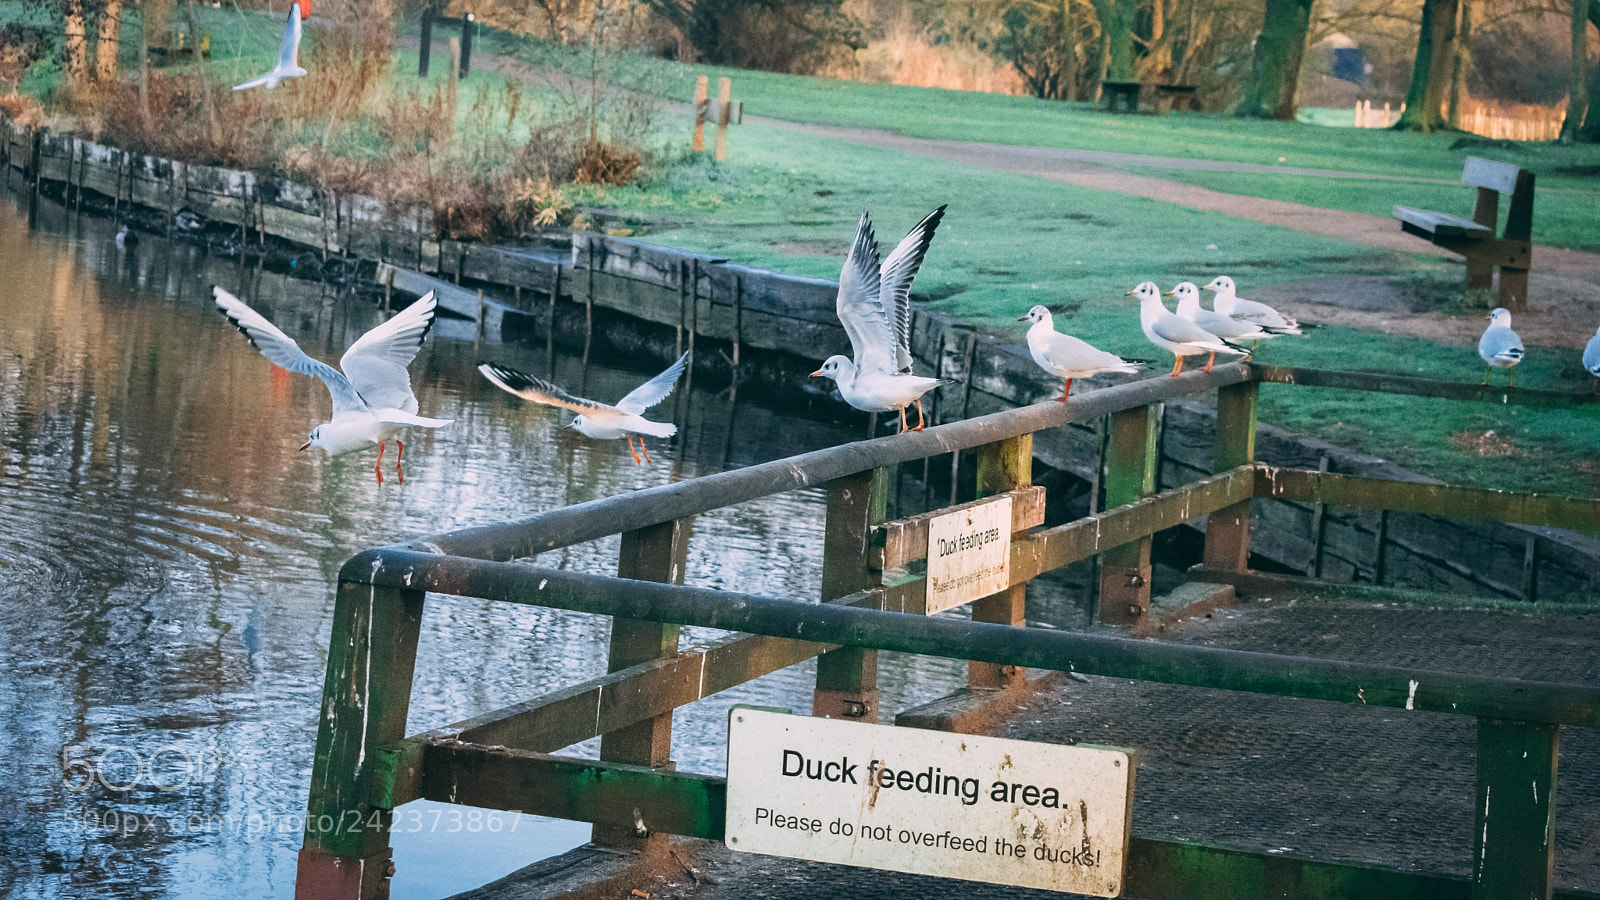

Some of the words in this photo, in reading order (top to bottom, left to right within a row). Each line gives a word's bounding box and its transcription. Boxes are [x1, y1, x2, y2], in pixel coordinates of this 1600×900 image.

[939, 533, 958, 557] Duck
[959, 529, 983, 550] feeding
[782, 749, 858, 785] Duck
[867, 759, 980, 806] feeding
[990, 780, 1068, 809] area.
[755, 807, 822, 833] Please
[829, 817, 854, 837] do
[861, 824, 892, 842] not
[898, 829, 987, 854] overfeed
[994, 838, 1026, 858] the
[1033, 842, 1101, 868] ducks!
